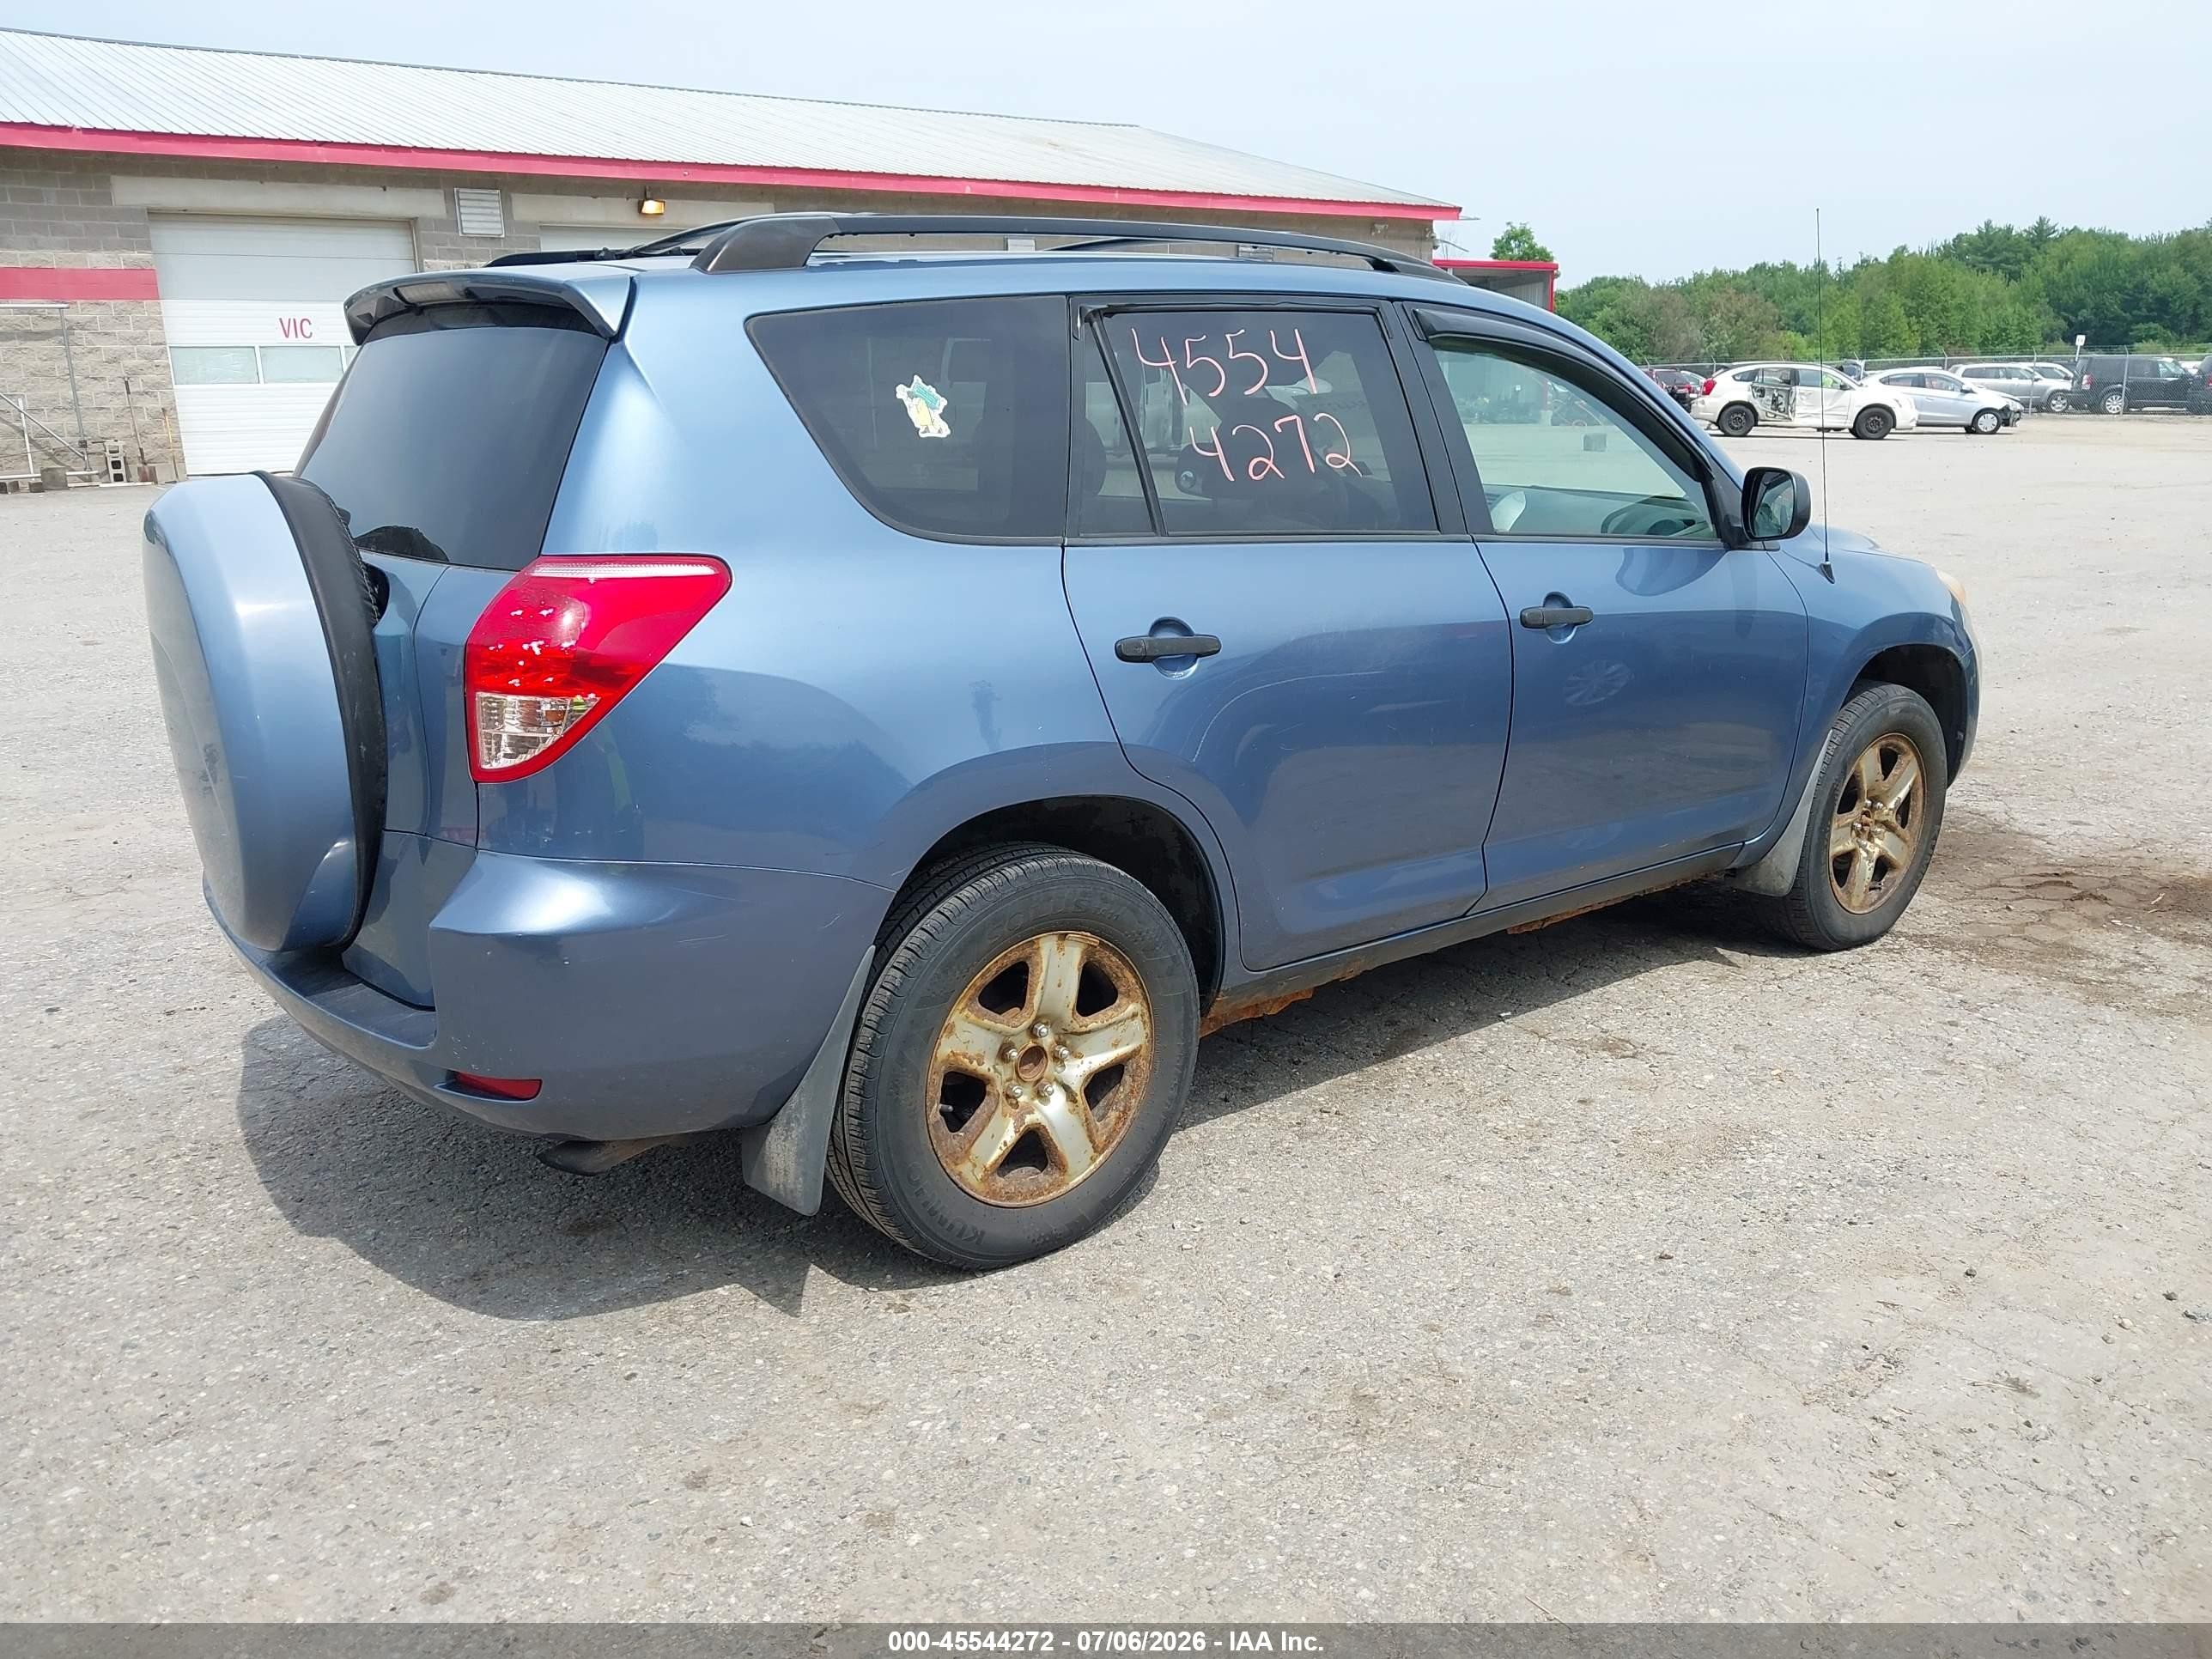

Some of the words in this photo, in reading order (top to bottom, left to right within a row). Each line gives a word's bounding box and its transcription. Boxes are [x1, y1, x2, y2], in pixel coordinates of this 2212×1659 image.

[279, 318, 313, 338] VIC
[1131, 327, 1317, 406] 4554
[1189, 412, 1363, 482] 4272
